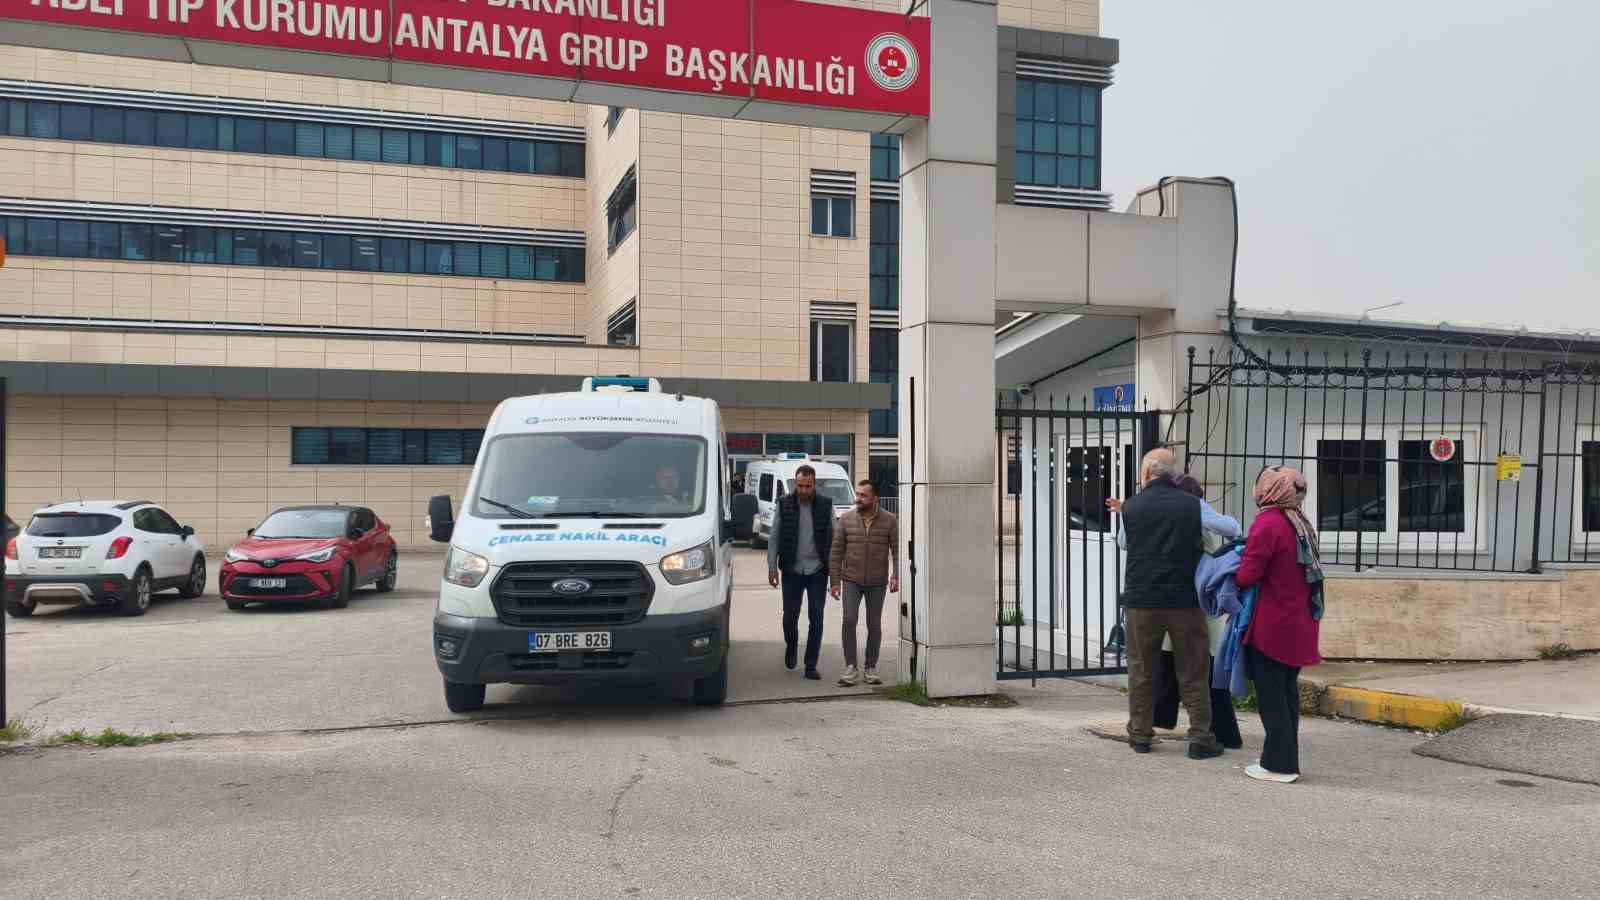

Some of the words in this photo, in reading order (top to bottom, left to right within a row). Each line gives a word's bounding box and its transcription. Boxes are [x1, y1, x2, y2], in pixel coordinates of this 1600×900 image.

[488, 0, 665, 26] NLIĞI
[216, 0, 383, 42] KURUMU
[394, 13, 547, 61] ANTALYA
[559, 32, 648, 72] GRUP
[665, 44, 855, 96] BAŞKANLIĞI
[489, 533, 555, 547] CENAZE
[560, 531, 610, 541] NAKİL
[536, 634, 551, 648] 07
[556, 633, 578, 648] BRE
[585, 633, 608, 647] 826
